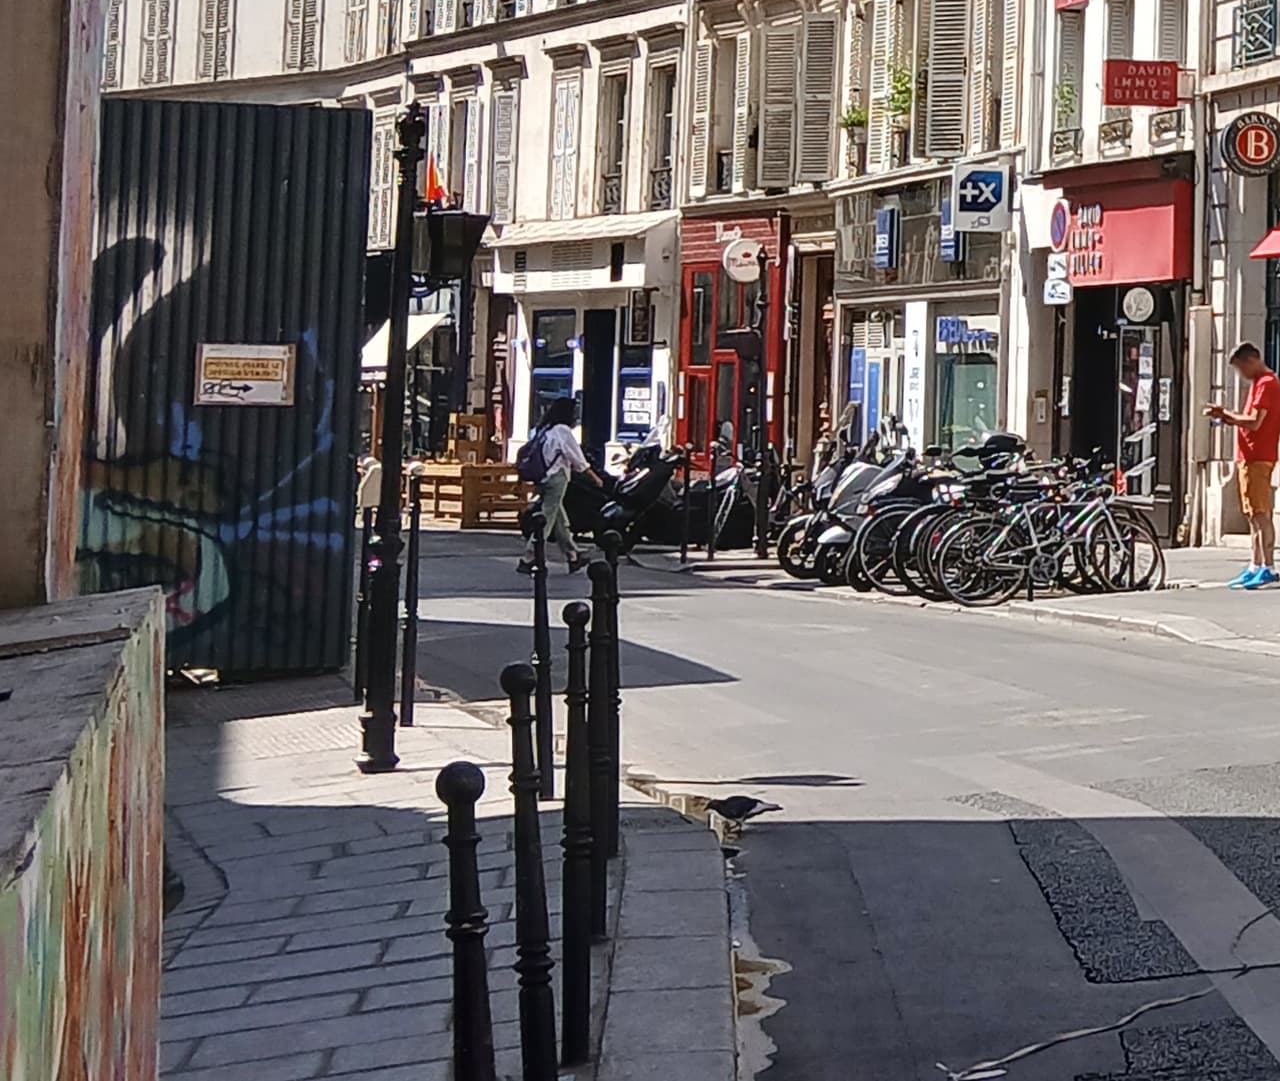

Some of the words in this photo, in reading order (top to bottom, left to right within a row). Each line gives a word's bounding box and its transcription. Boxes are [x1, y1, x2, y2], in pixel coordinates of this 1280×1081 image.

[1127, 64, 1172, 76] DAVID
[1114, 89, 1172, 100] BILIER
[1247, 130, 1269, 159] B
